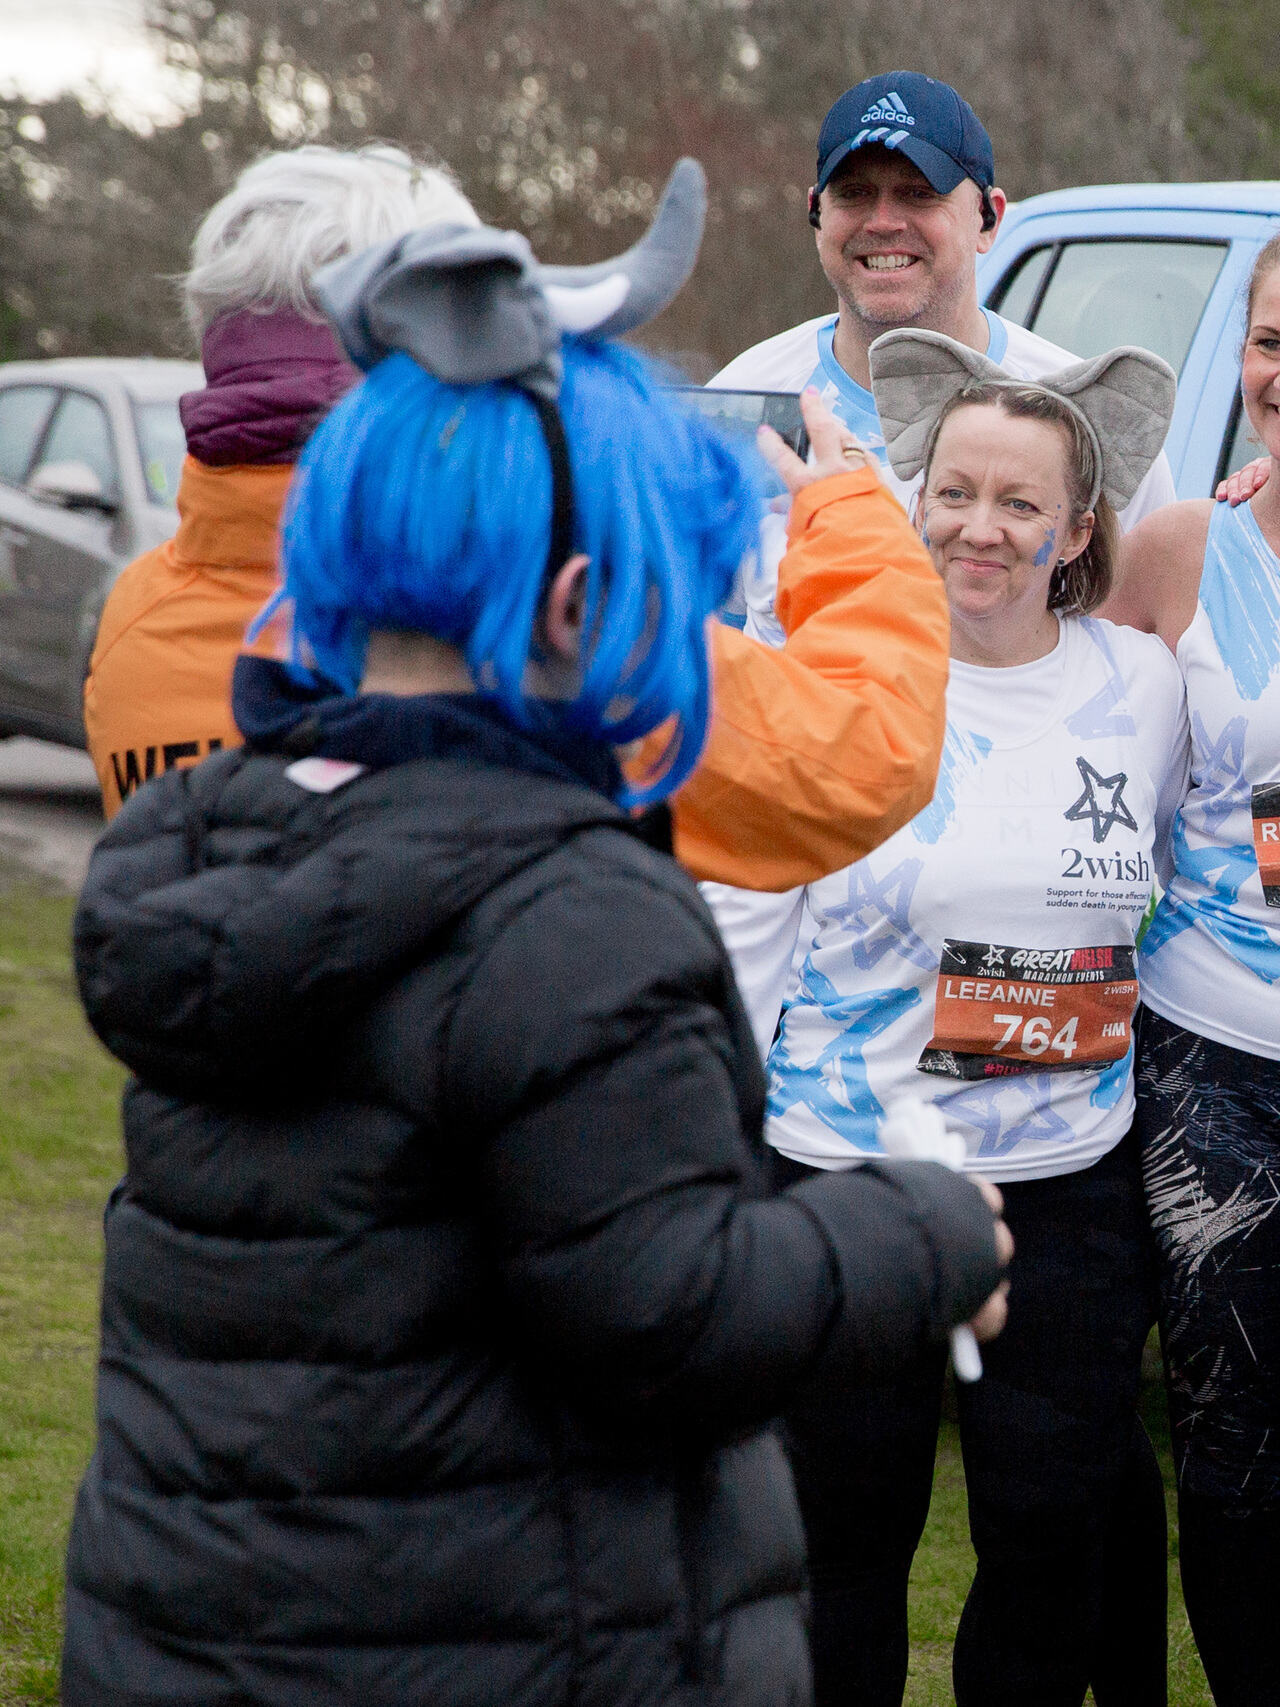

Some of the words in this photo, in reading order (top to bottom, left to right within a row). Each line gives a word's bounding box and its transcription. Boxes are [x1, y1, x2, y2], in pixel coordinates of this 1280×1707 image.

[861, 110, 915, 126] adidas
[1061, 848, 1150, 882] 2wish
[1046, 888, 1082, 898] Support
[1086, 889, 1099, 898] for
[1102, 890, 1124, 900] those
[1046, 900, 1078, 908] sudden
[1081, 901, 1106, 910] death
[1108, 902, 1116, 910] in
[977, 966, 1006, 978] 2wish
[1023, 970, 1072, 983] MARATHON
[1075, 970, 1104, 982] EVENTS
[944, 980, 1056, 1008] LEEANNE
[1111, 986, 1134, 994] WISH
[992, 1014, 1080, 1059] 764
[1102, 1022, 1126, 1038] HM
